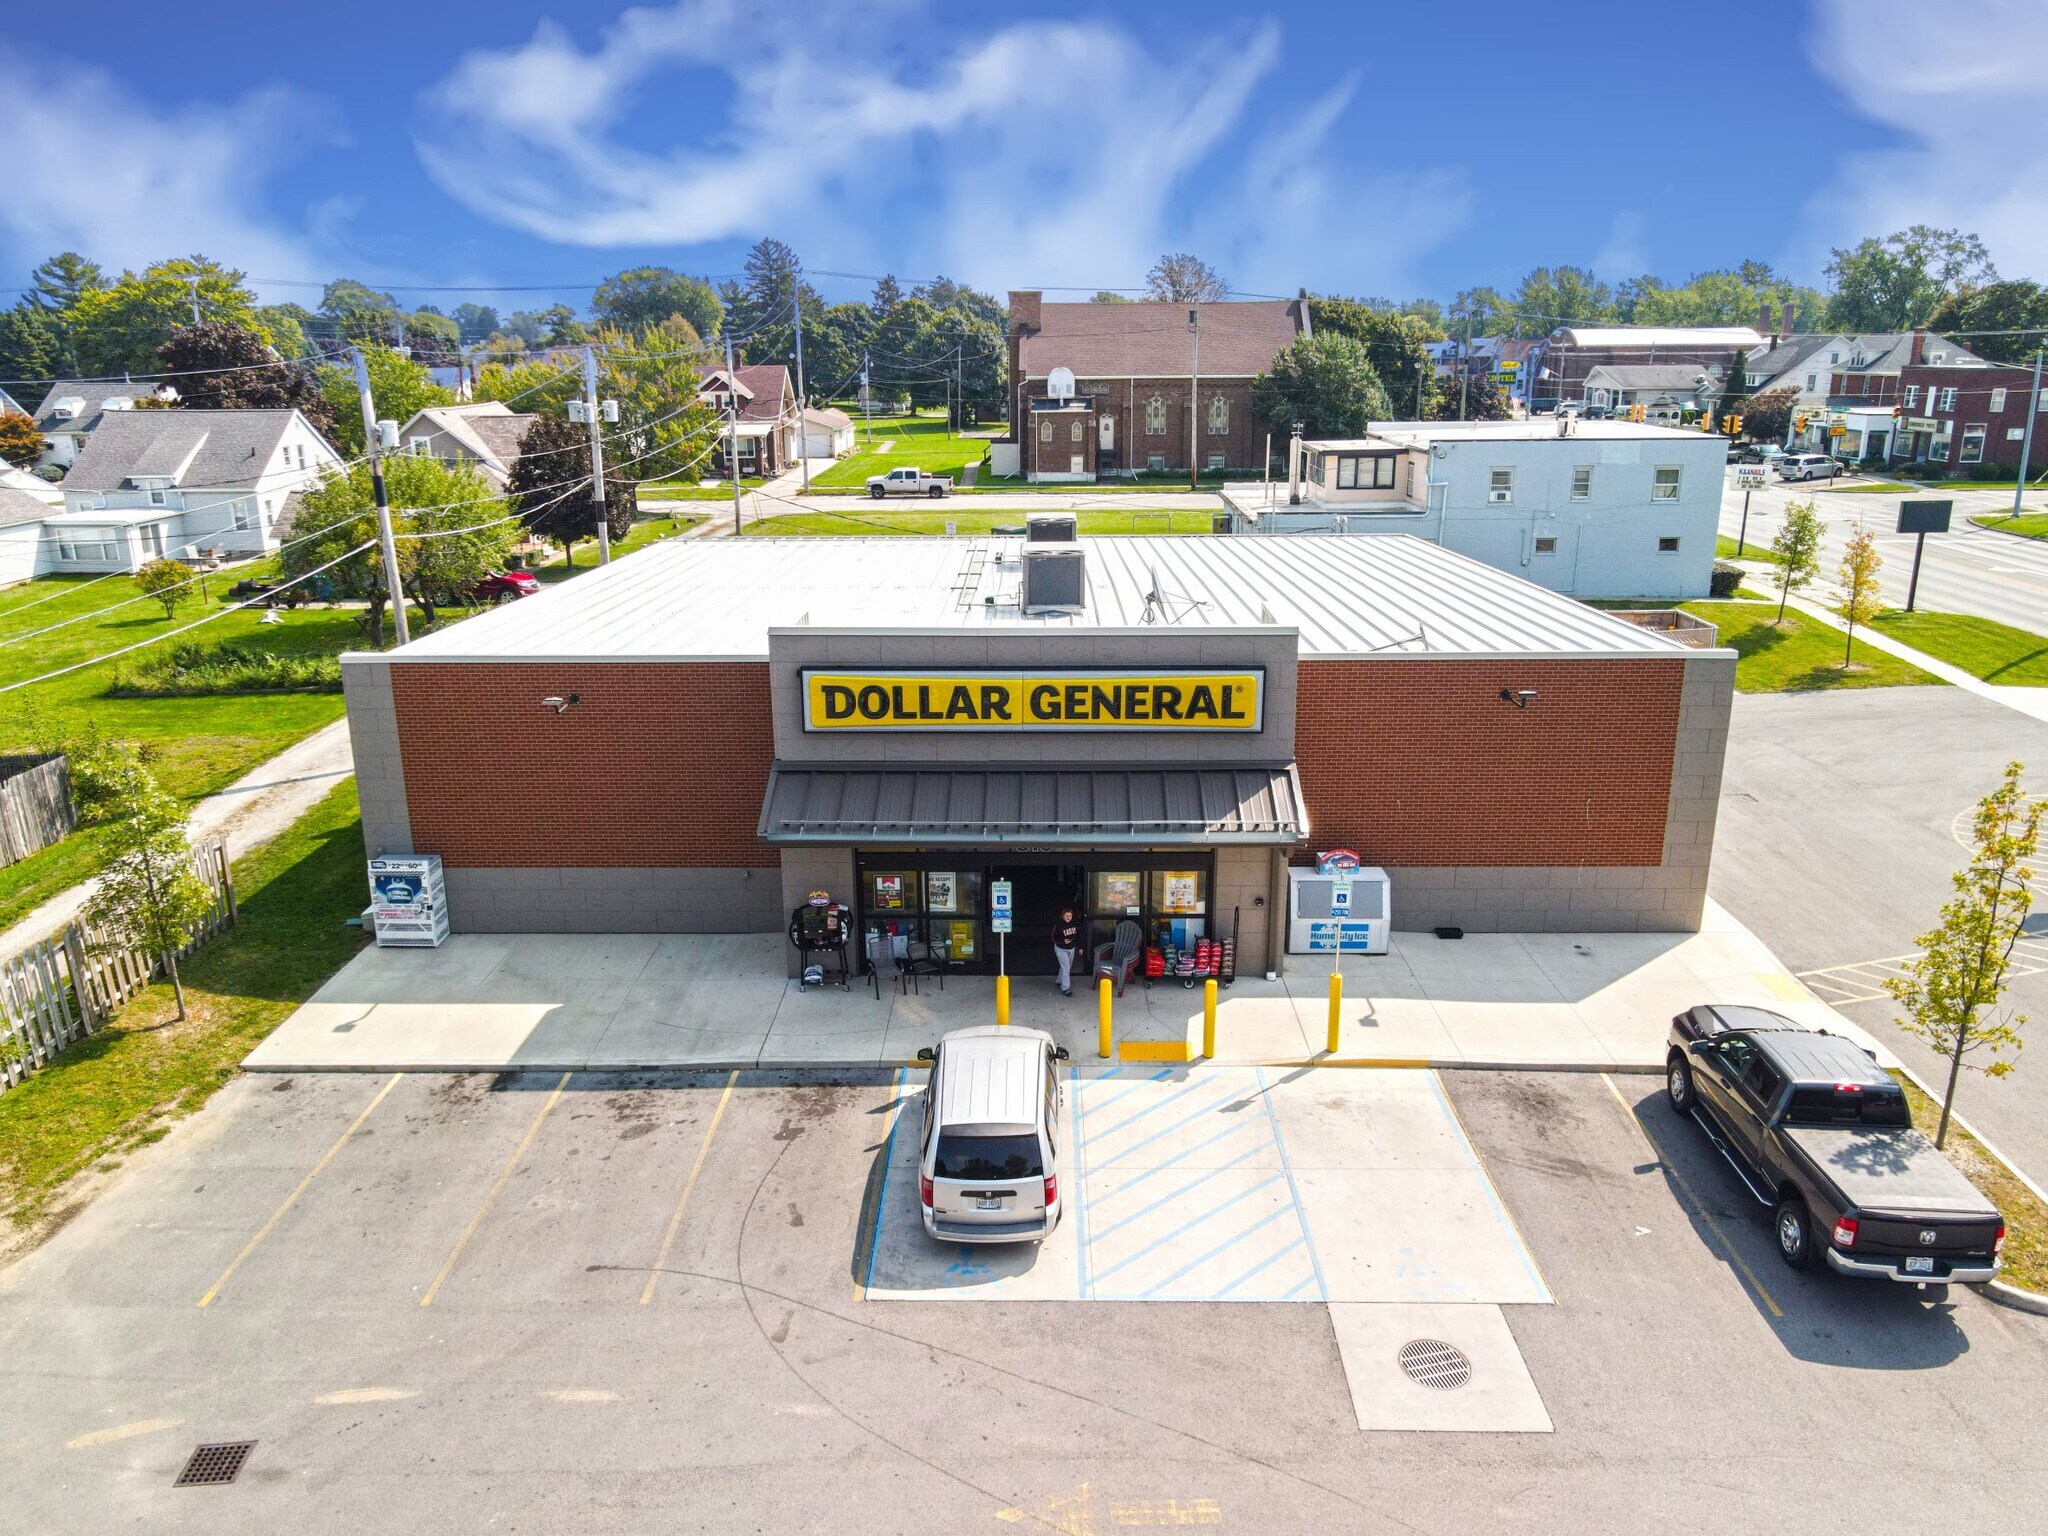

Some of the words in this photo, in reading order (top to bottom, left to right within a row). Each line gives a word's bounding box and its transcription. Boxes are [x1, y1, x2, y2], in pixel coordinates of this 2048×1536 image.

[821, 684, 1012, 720] DOLLAR
[1030, 684, 1246, 720] GENERAL
[1310, 932, 1336, 940] Home
[1354, 932, 1368, 940] Ice
